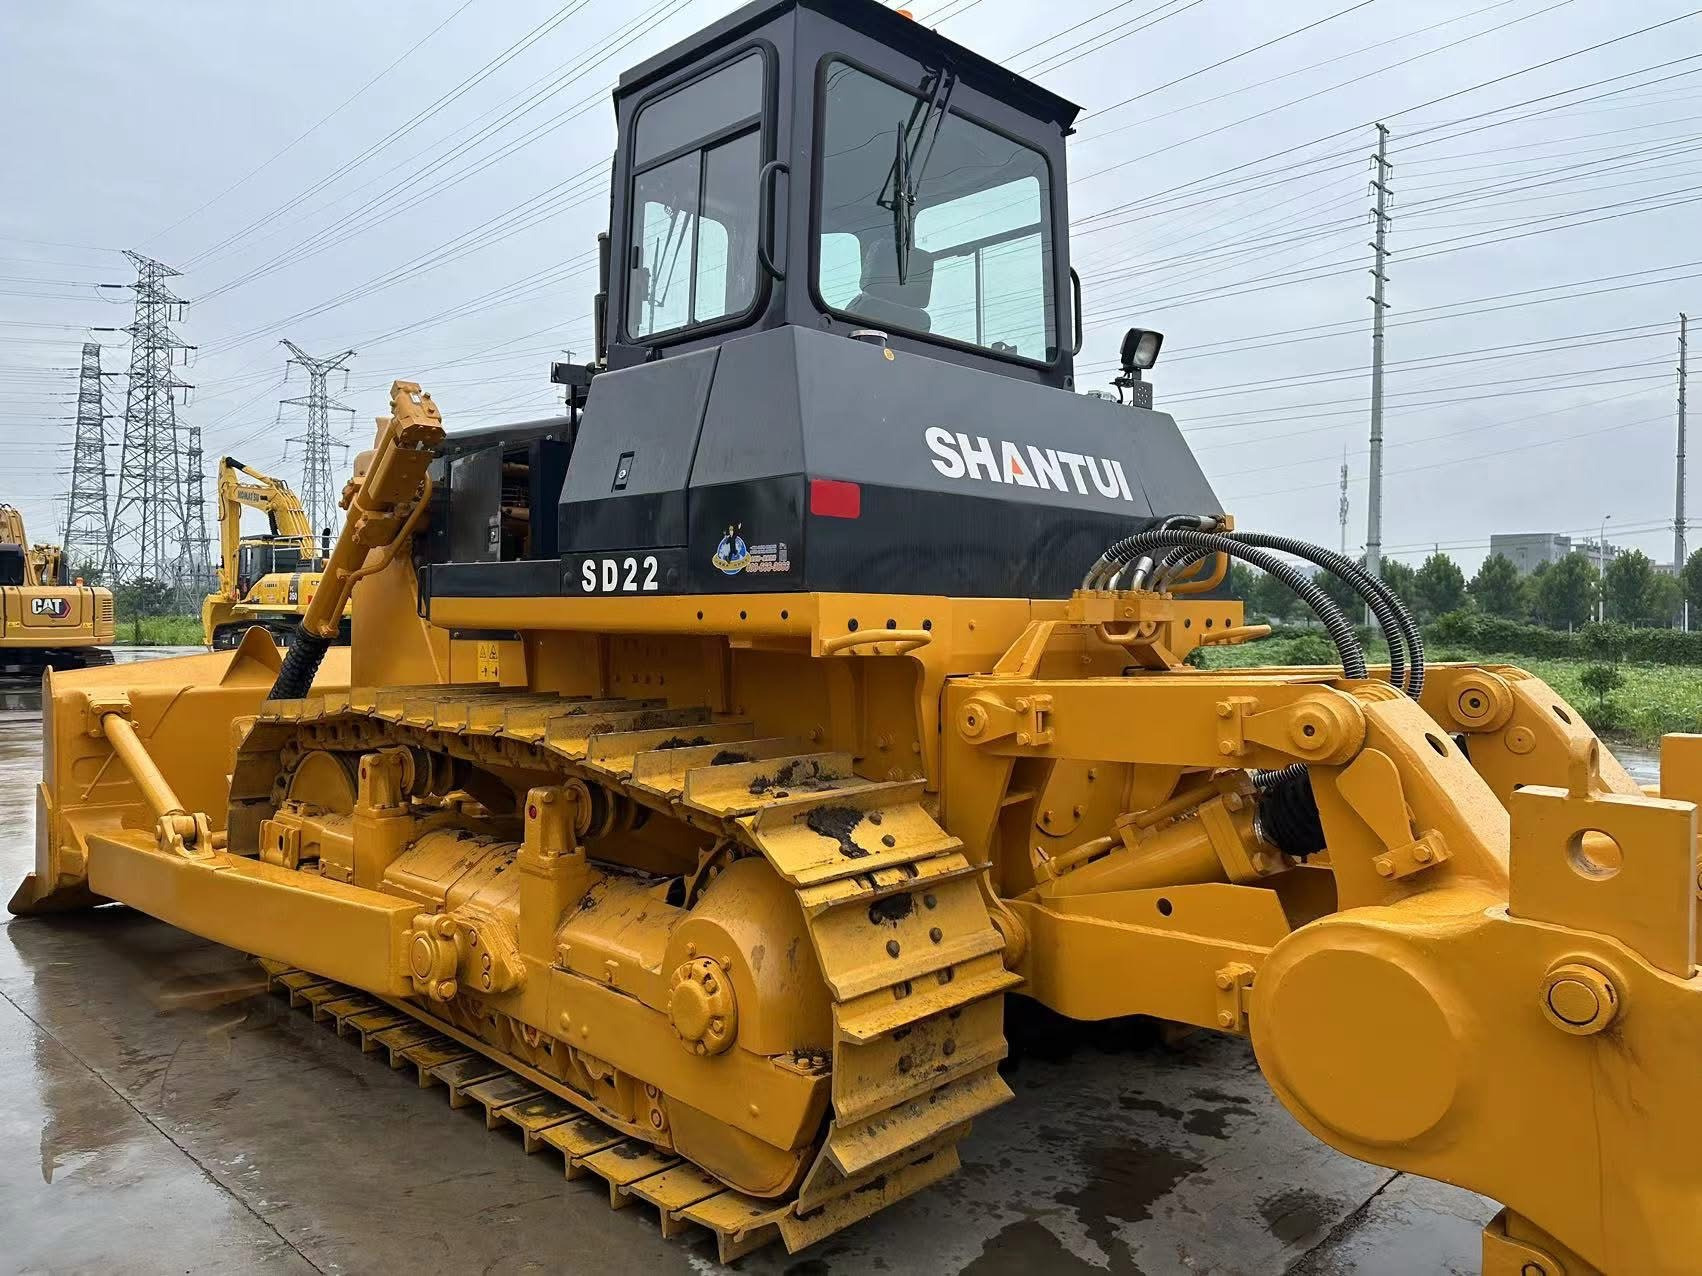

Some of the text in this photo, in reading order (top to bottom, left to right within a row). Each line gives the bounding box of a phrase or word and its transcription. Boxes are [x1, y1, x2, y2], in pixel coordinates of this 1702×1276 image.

[925, 426, 1133, 501] SHANTUI
[581, 556, 658, 592] SD22
[31, 598, 62, 614] CAT
